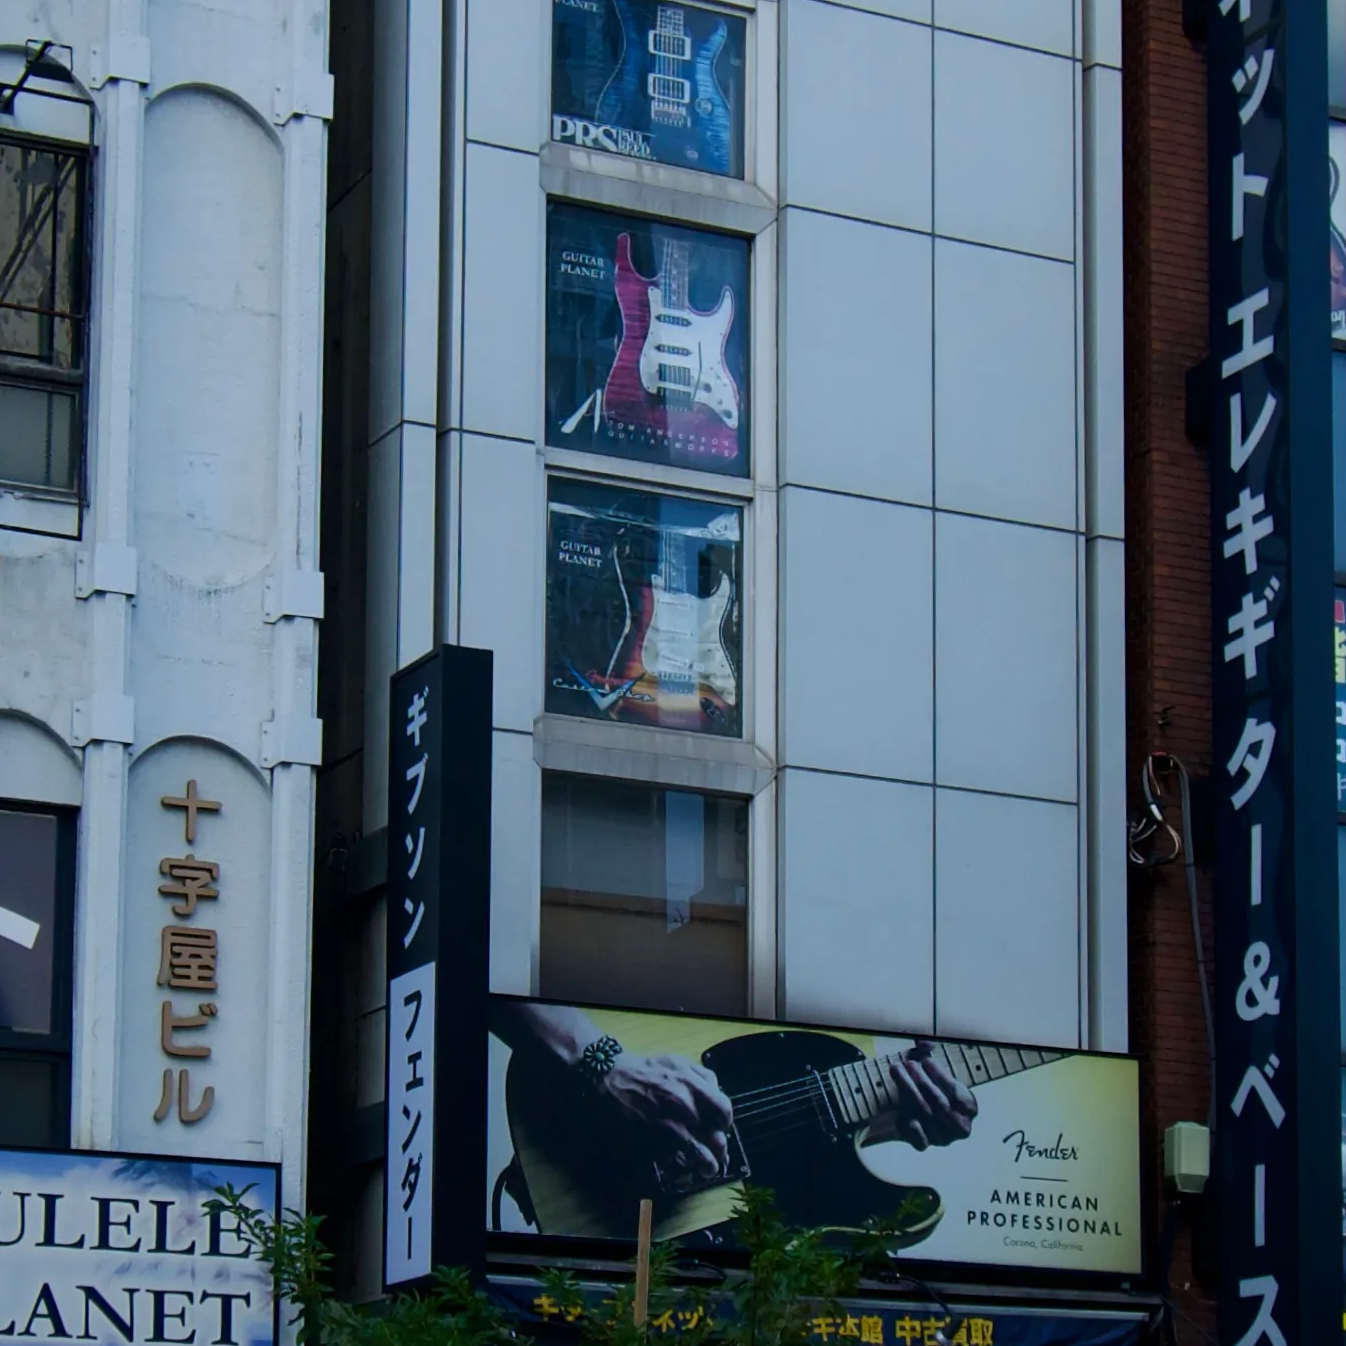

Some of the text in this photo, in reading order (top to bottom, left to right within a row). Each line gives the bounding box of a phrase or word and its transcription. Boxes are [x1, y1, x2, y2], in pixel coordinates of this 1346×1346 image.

[553, 117, 619, 153] PRS
[560, 263, 606, 279] PLANET
[562, 251, 604, 268] GUITAR
[558, 551, 603, 569] PLANET
[561, 540, 602, 556] GUITAR
[406, 684, 430, 950] ギブソン
[153, 778, 224, 1126] 十字屋ビル
[401, 988, 424, 1260] フェンダー
[1002, 1129, 1079, 1164] Fender
[989, 1189, 1100, 1212] AMERICAN
[966, 1211, 1124, 1237] PROFESSIONAL
